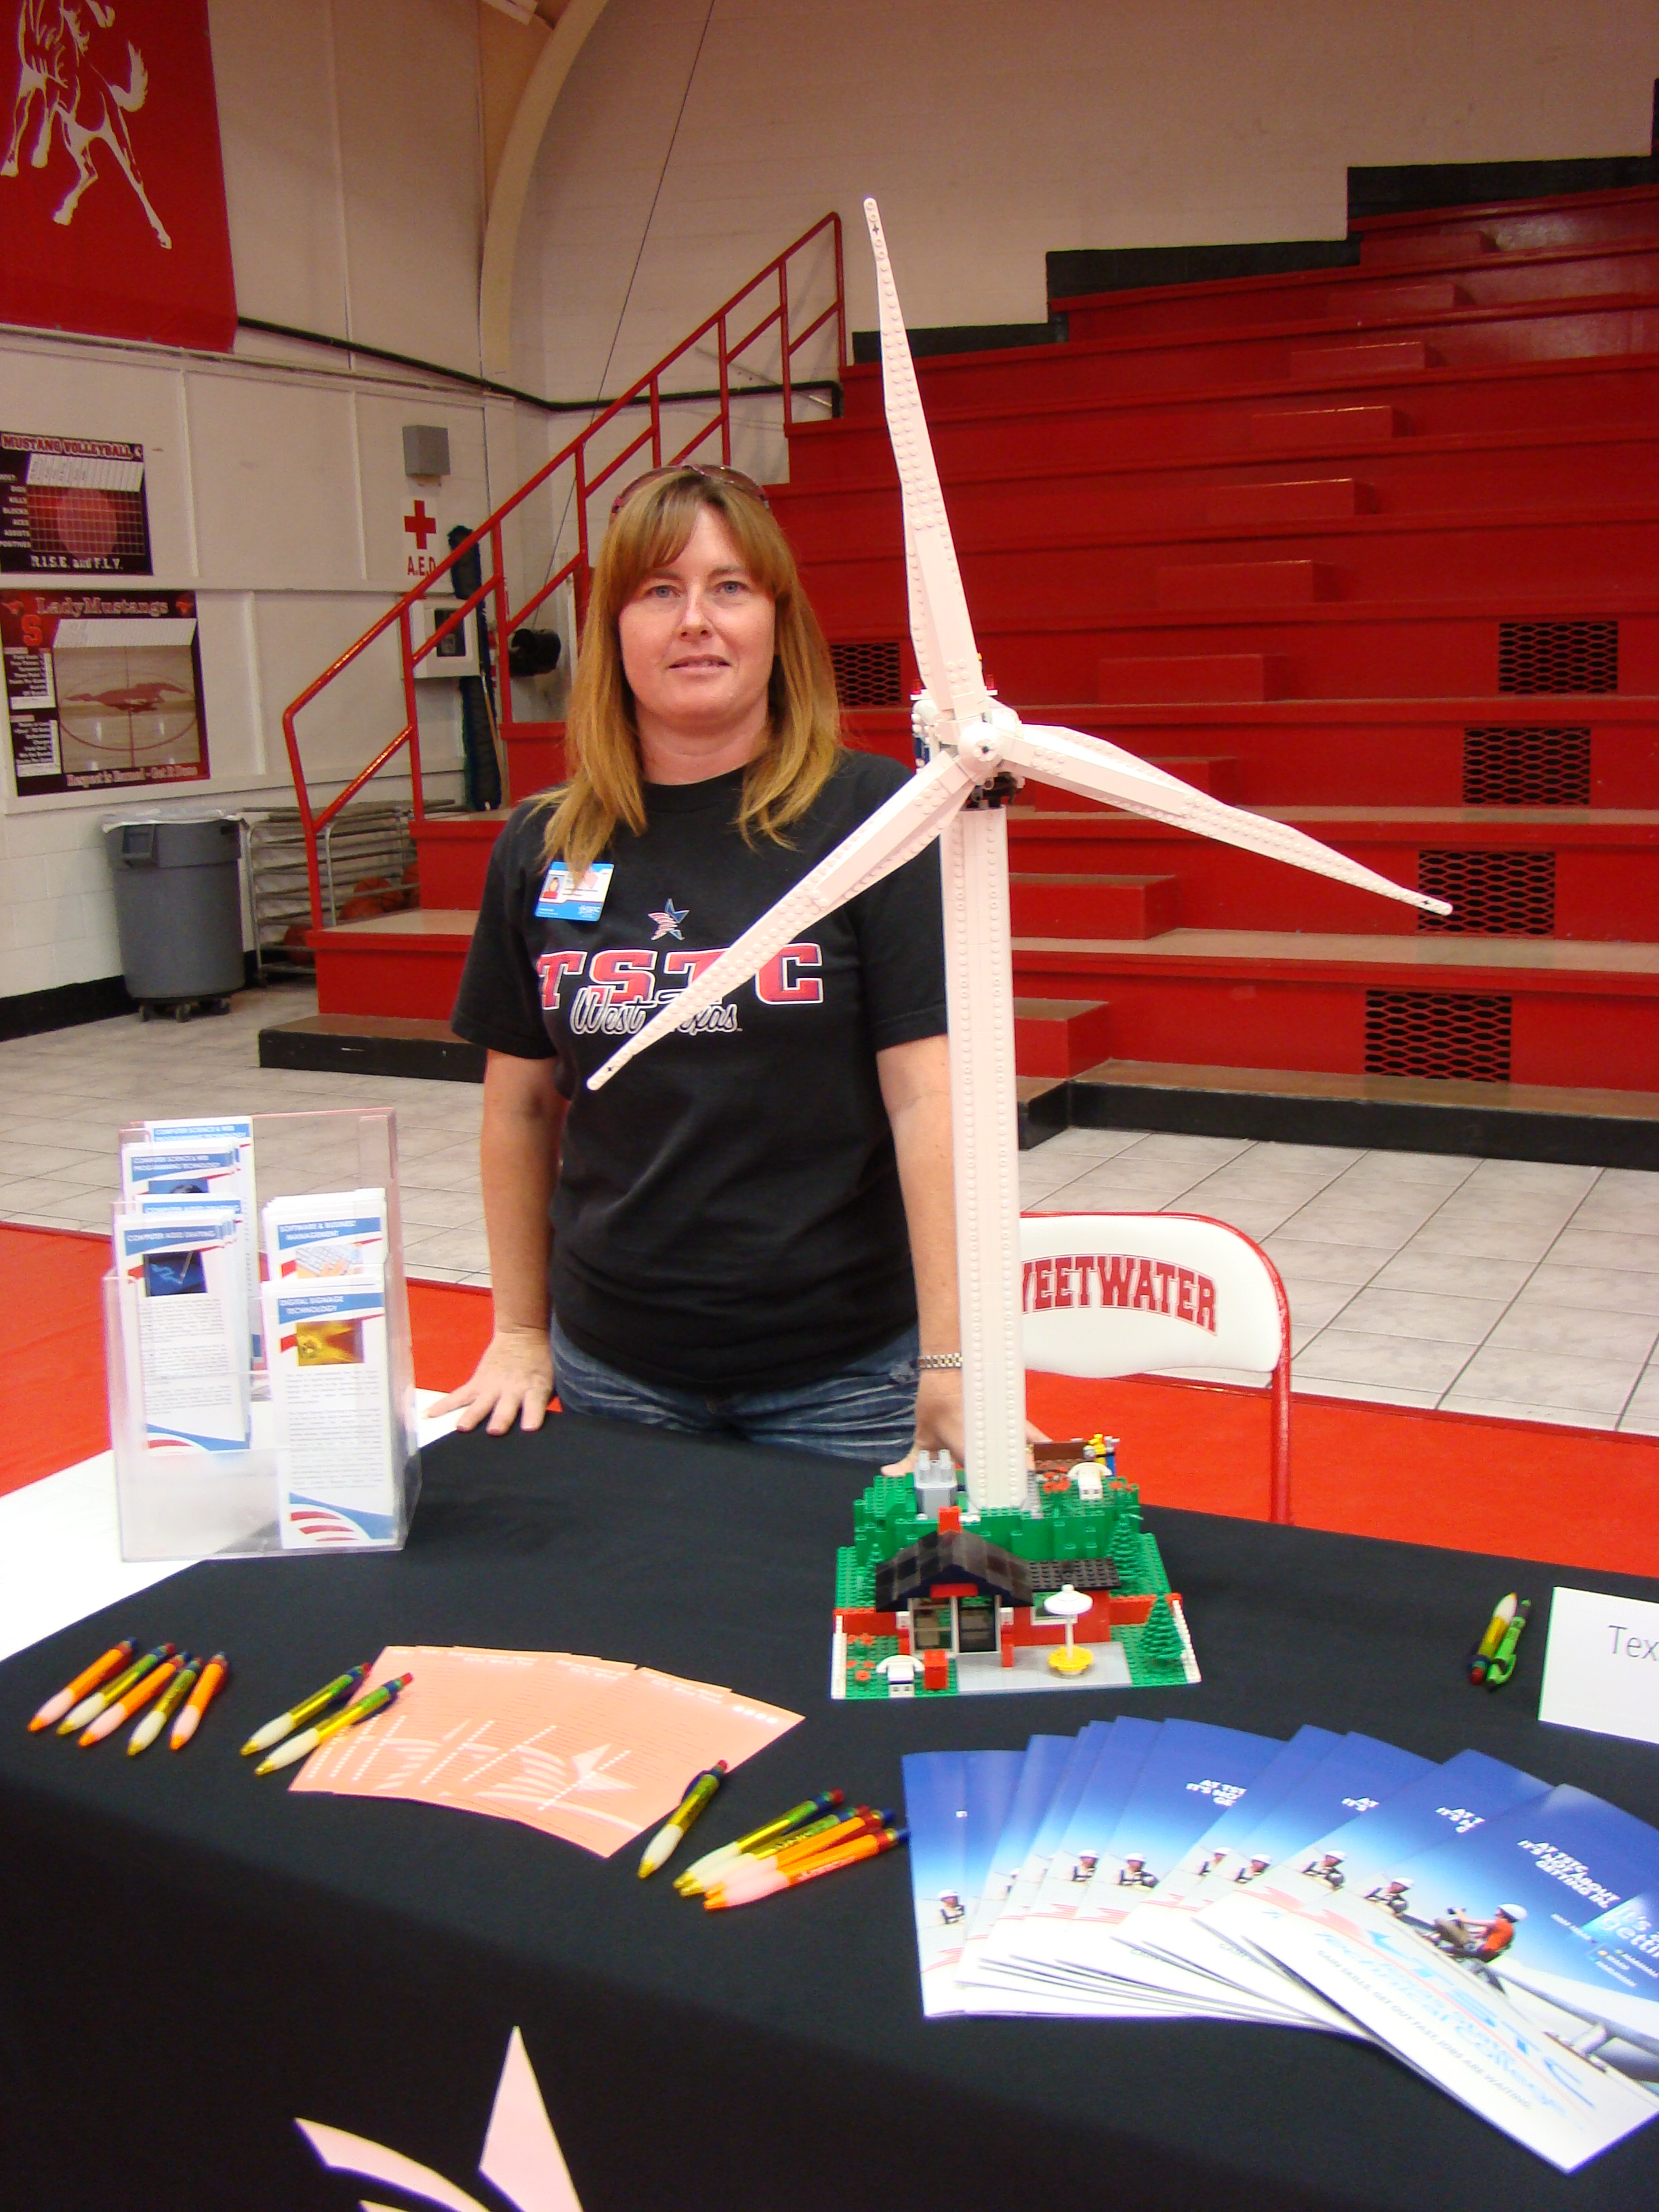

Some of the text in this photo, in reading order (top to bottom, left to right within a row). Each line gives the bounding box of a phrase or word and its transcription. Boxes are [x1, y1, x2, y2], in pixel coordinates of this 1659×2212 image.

[1, 434, 133, 460] MUSTANG VOLLEYBALL
[571, 987, 657, 1035] West
[1534, 1843, 1558, 1853] AT
[1570, 1872, 1620, 1901] ABOUT
